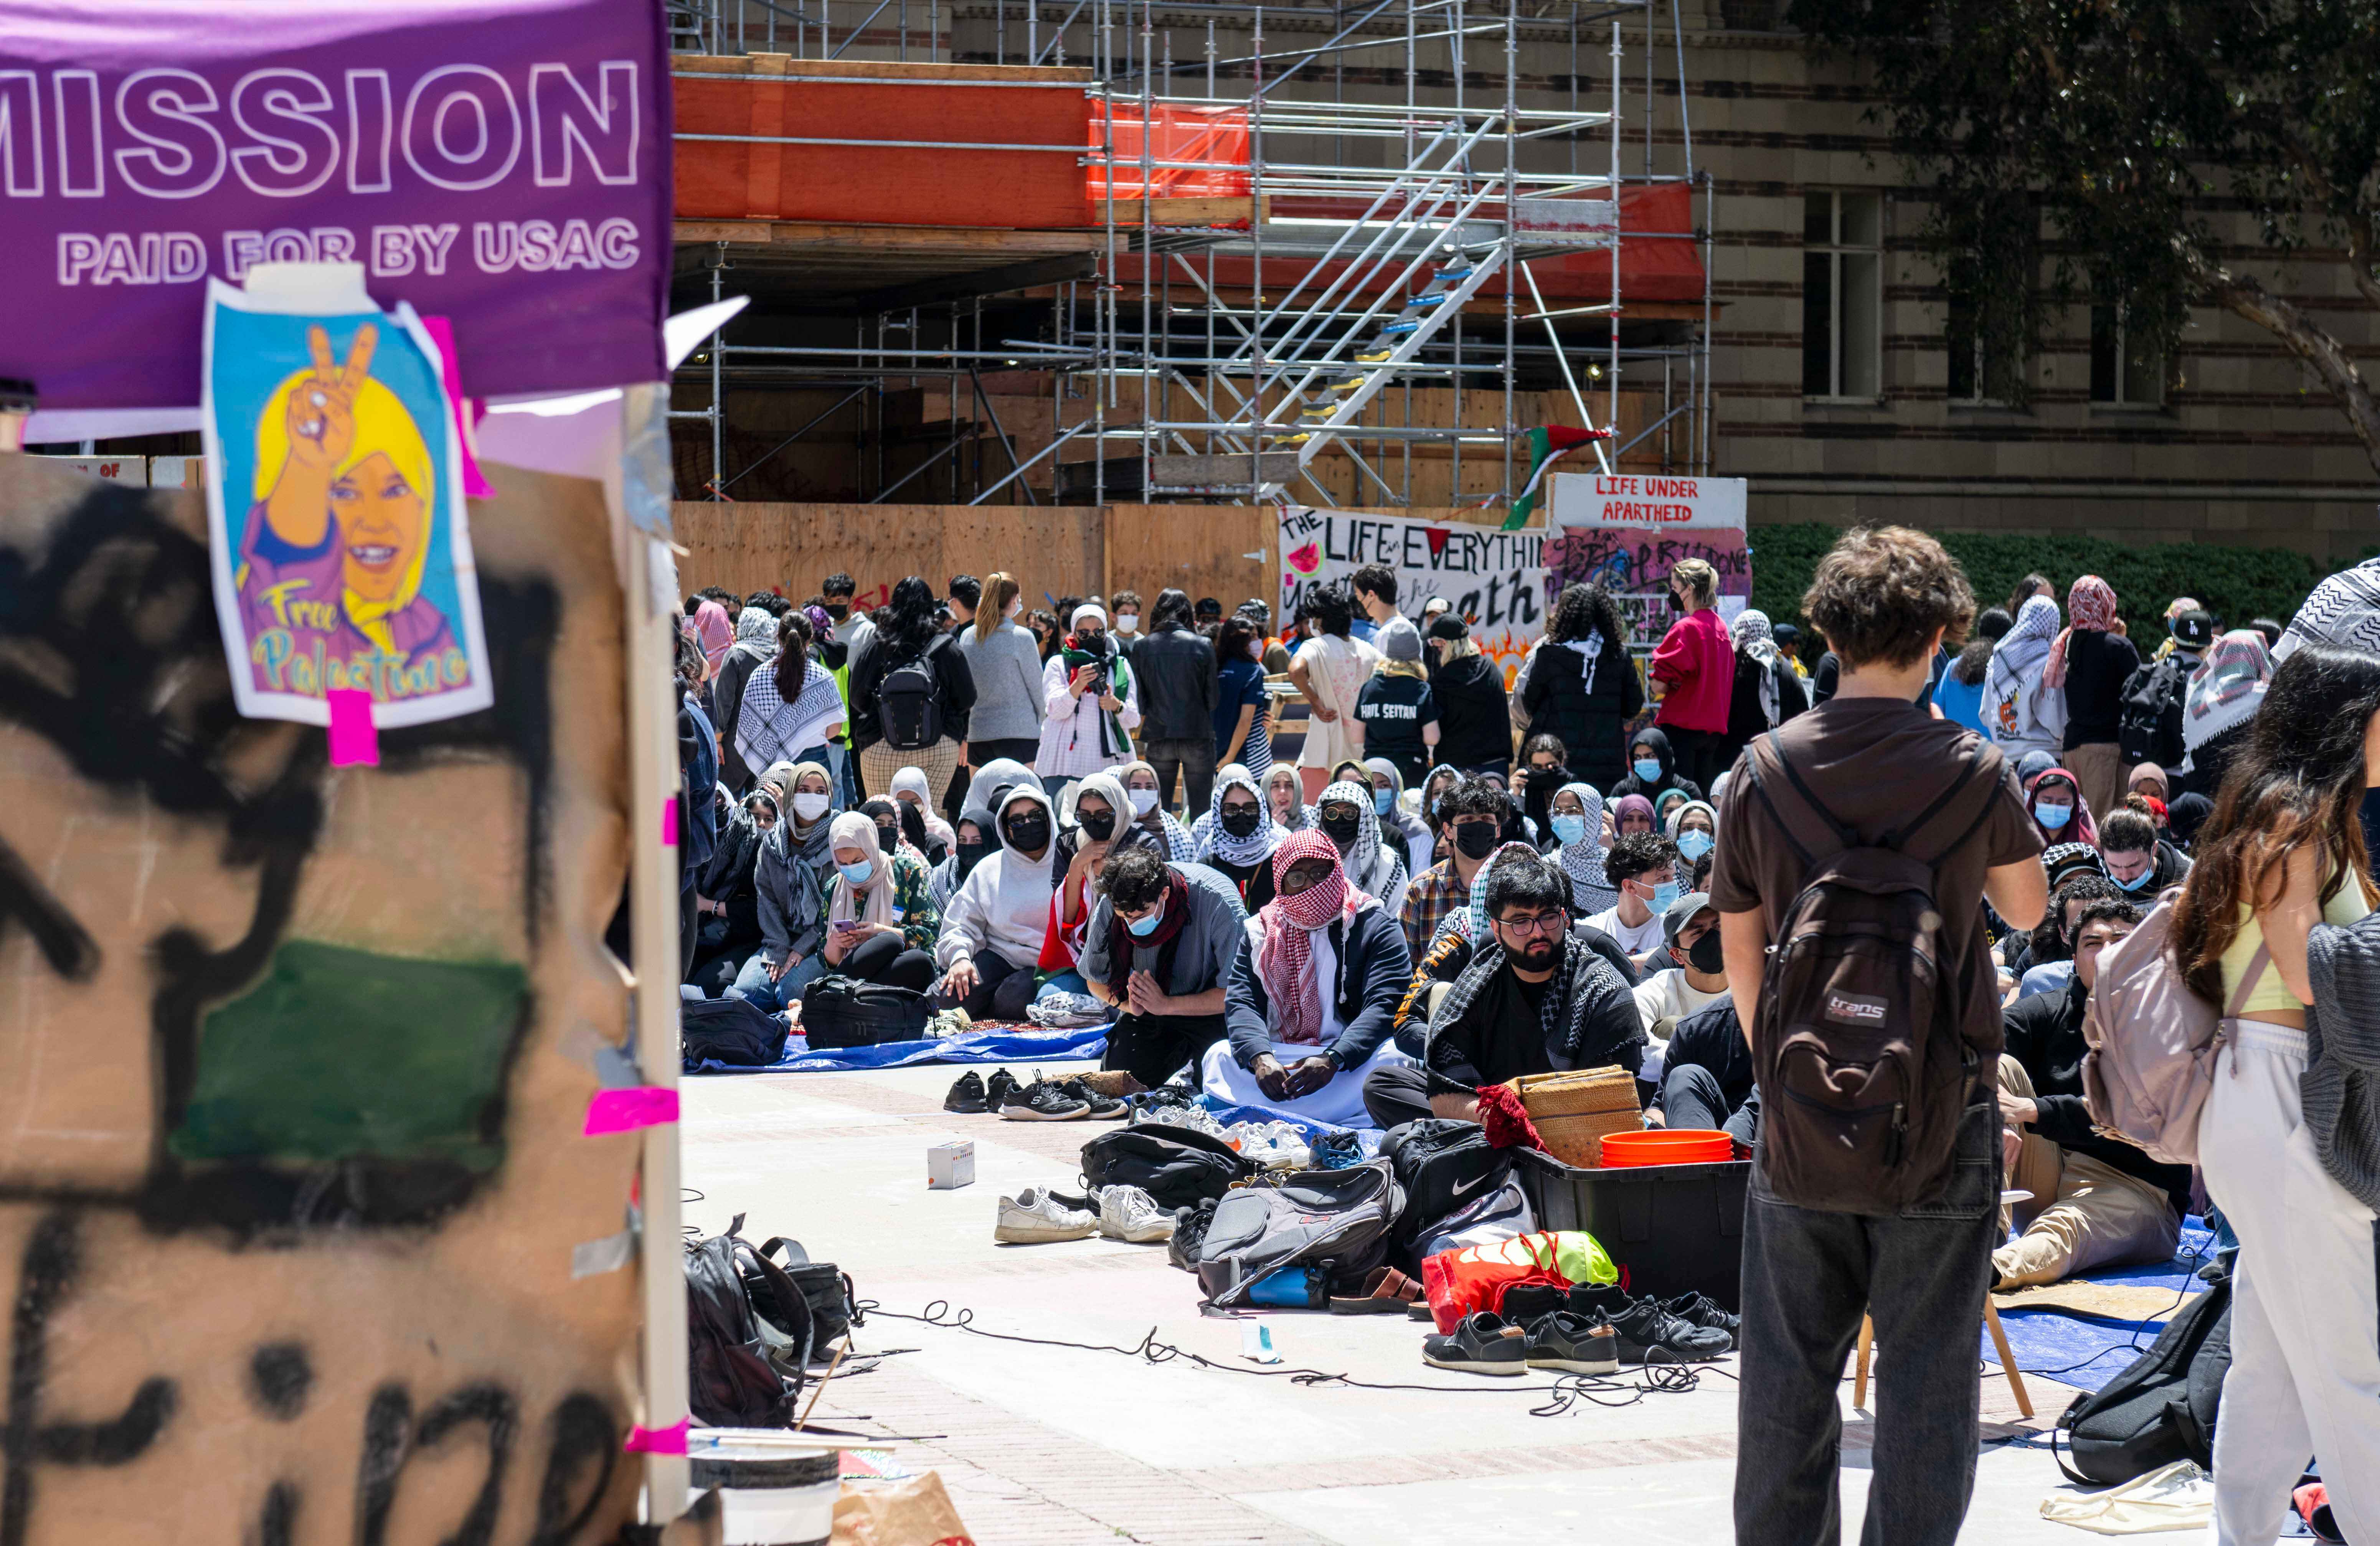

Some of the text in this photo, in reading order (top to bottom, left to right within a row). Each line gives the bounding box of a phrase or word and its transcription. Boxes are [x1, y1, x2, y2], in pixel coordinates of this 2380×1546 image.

[58, 231, 208, 285] PAID
[370, 223, 461, 277] BY
[472, 216, 640, 274] USAC
[100, 464, 120, 477] OF
[1596, 477, 1699, 498] LIFE UNDER
[1602, 501, 1693, 522] APARTHEID
[1281, 509, 1324, 540] THE
[1325, 516, 1395, 564] LIFE
[257, 577, 341, 633] Free
[252, 625, 469, 703] Palestine
[1360, 703, 1418, 719] HAIL SEITAN
[1830, 996, 1886, 1018] trans
